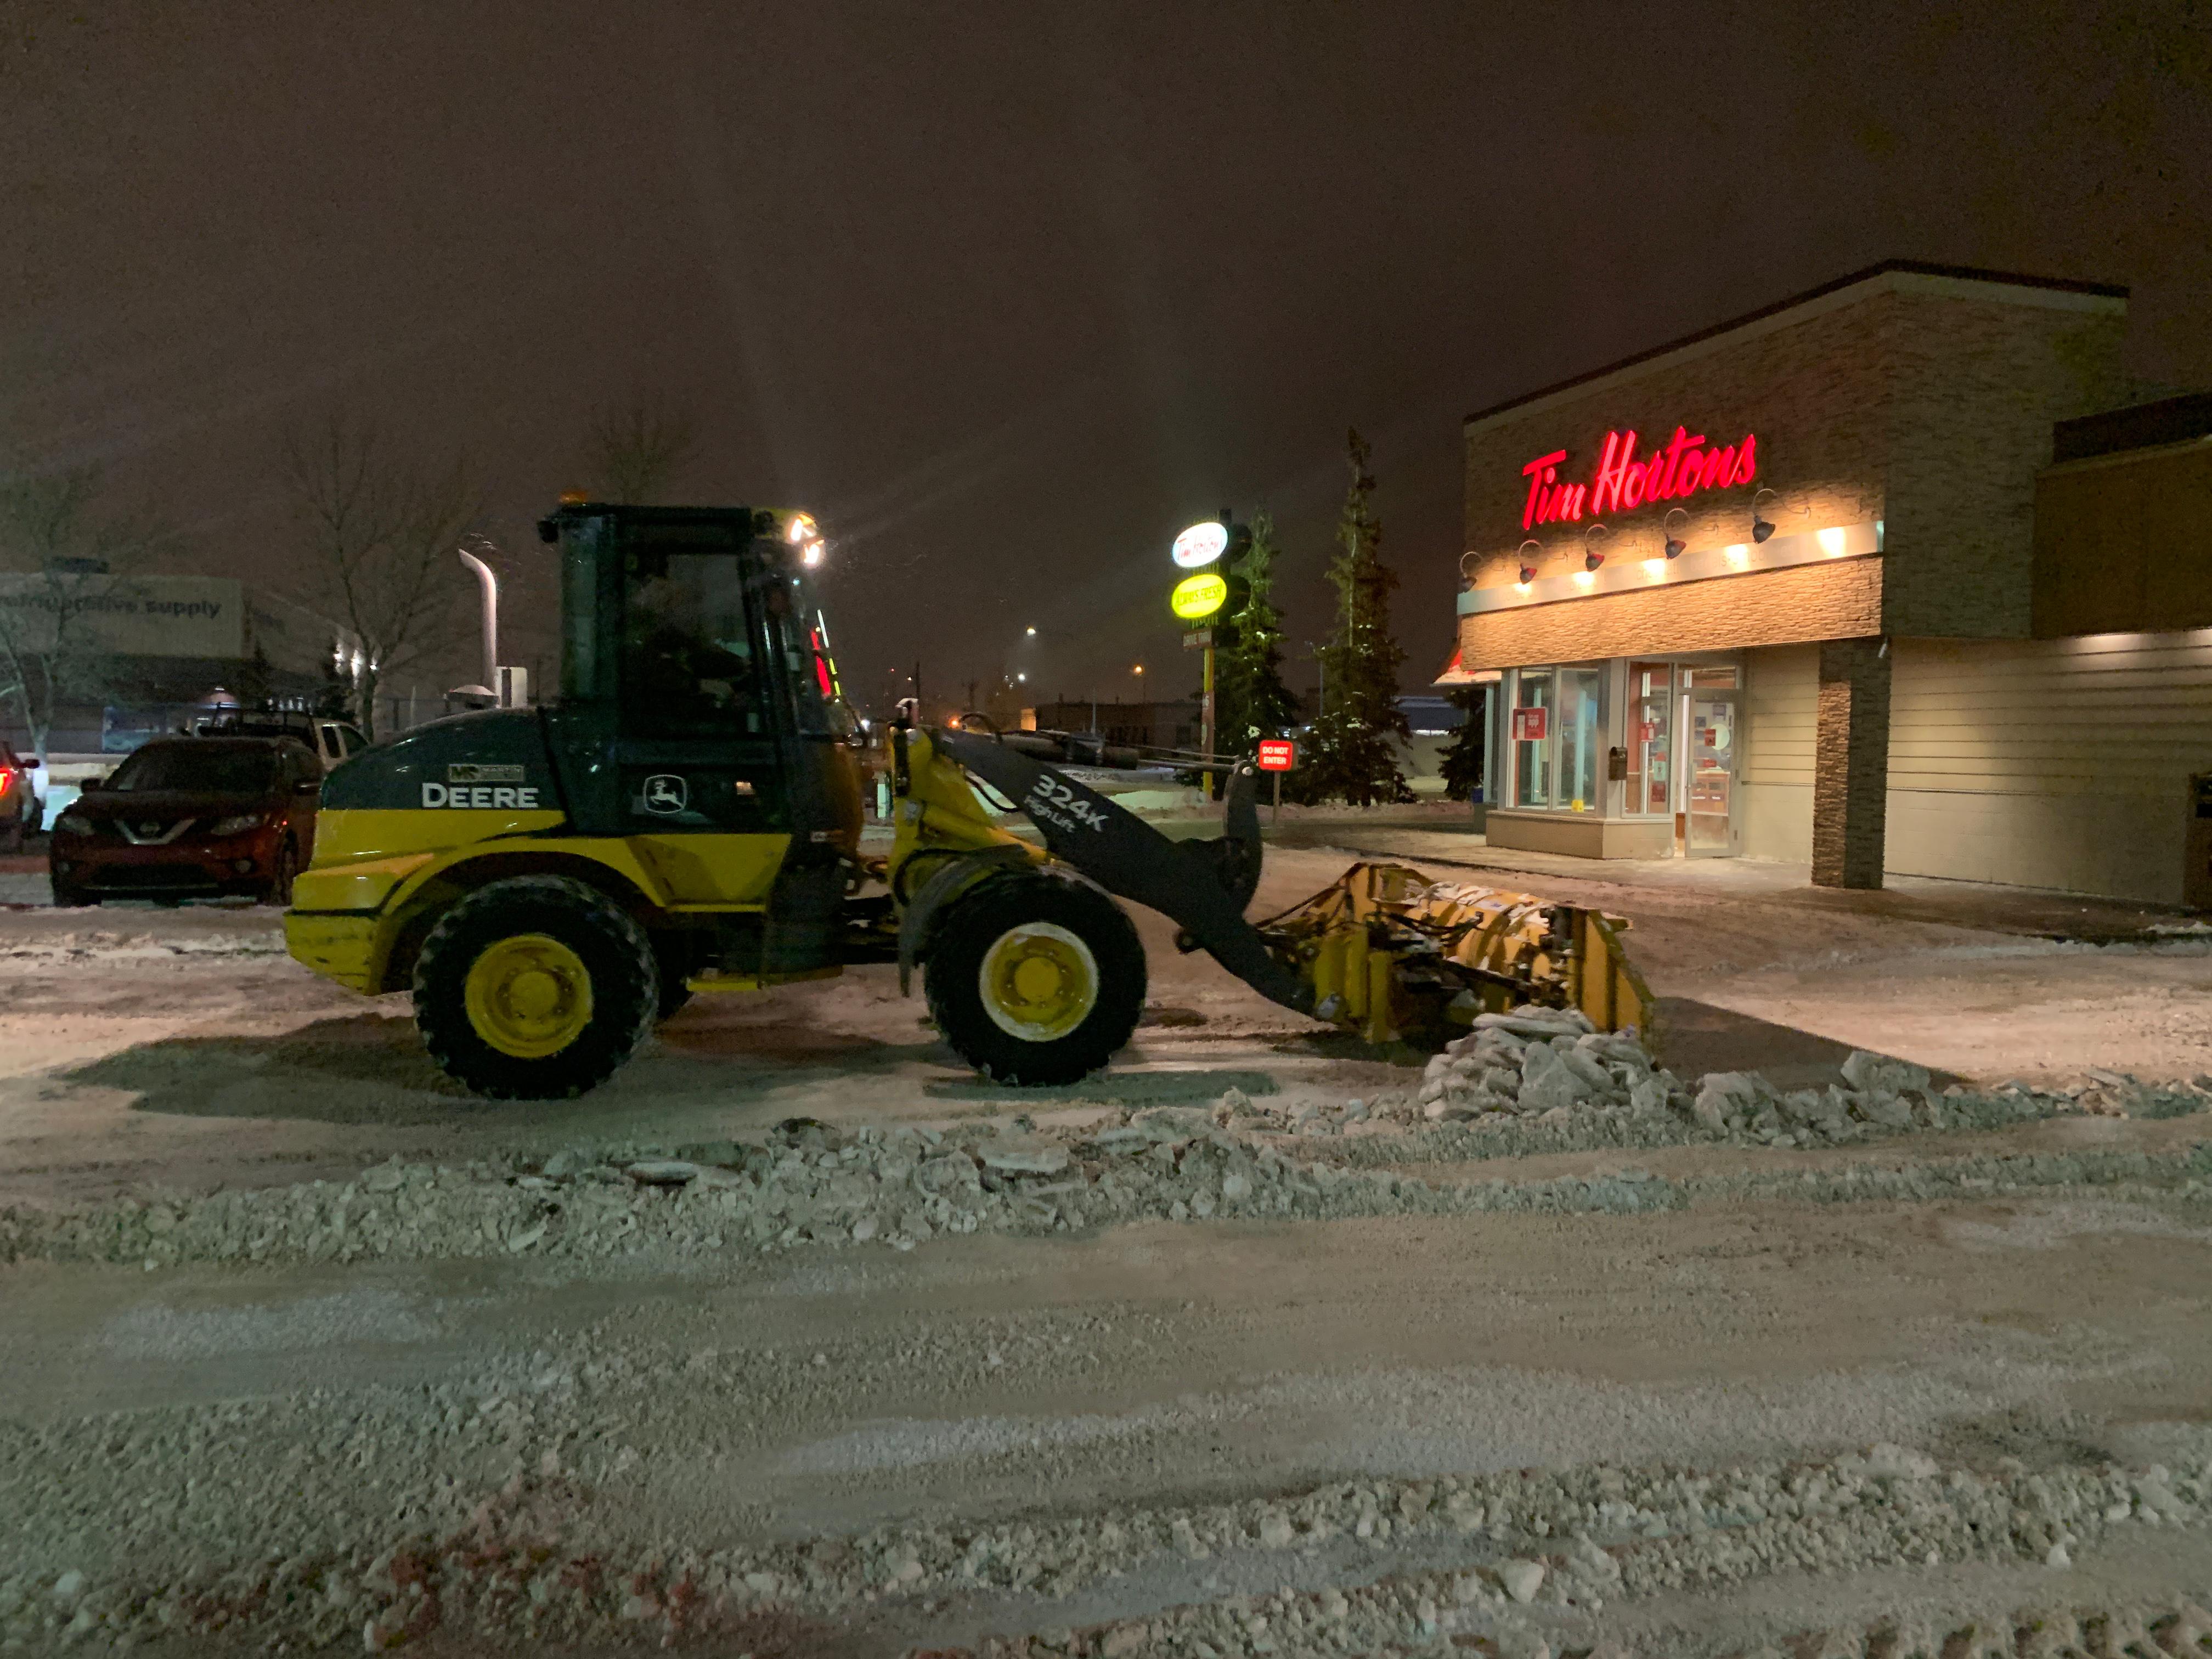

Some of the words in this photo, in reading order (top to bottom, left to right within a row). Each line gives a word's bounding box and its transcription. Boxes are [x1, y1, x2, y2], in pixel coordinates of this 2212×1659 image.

[1522, 449, 1585, 531] Tim
[1592, 425, 1756, 515] Hortons
[1177, 538, 1192, 560] Tim
[1193, 534, 1223, 555] Hortons
[1175, 590, 1200, 606] ALWAYS
[1200, 584, 1223, 602] FRESH
[1262, 746, 1273, 754] DO
[1274, 747, 1289, 755] NOT
[1263, 756, 1287, 765] ENTER
[422, 782, 539, 808] DEERE
